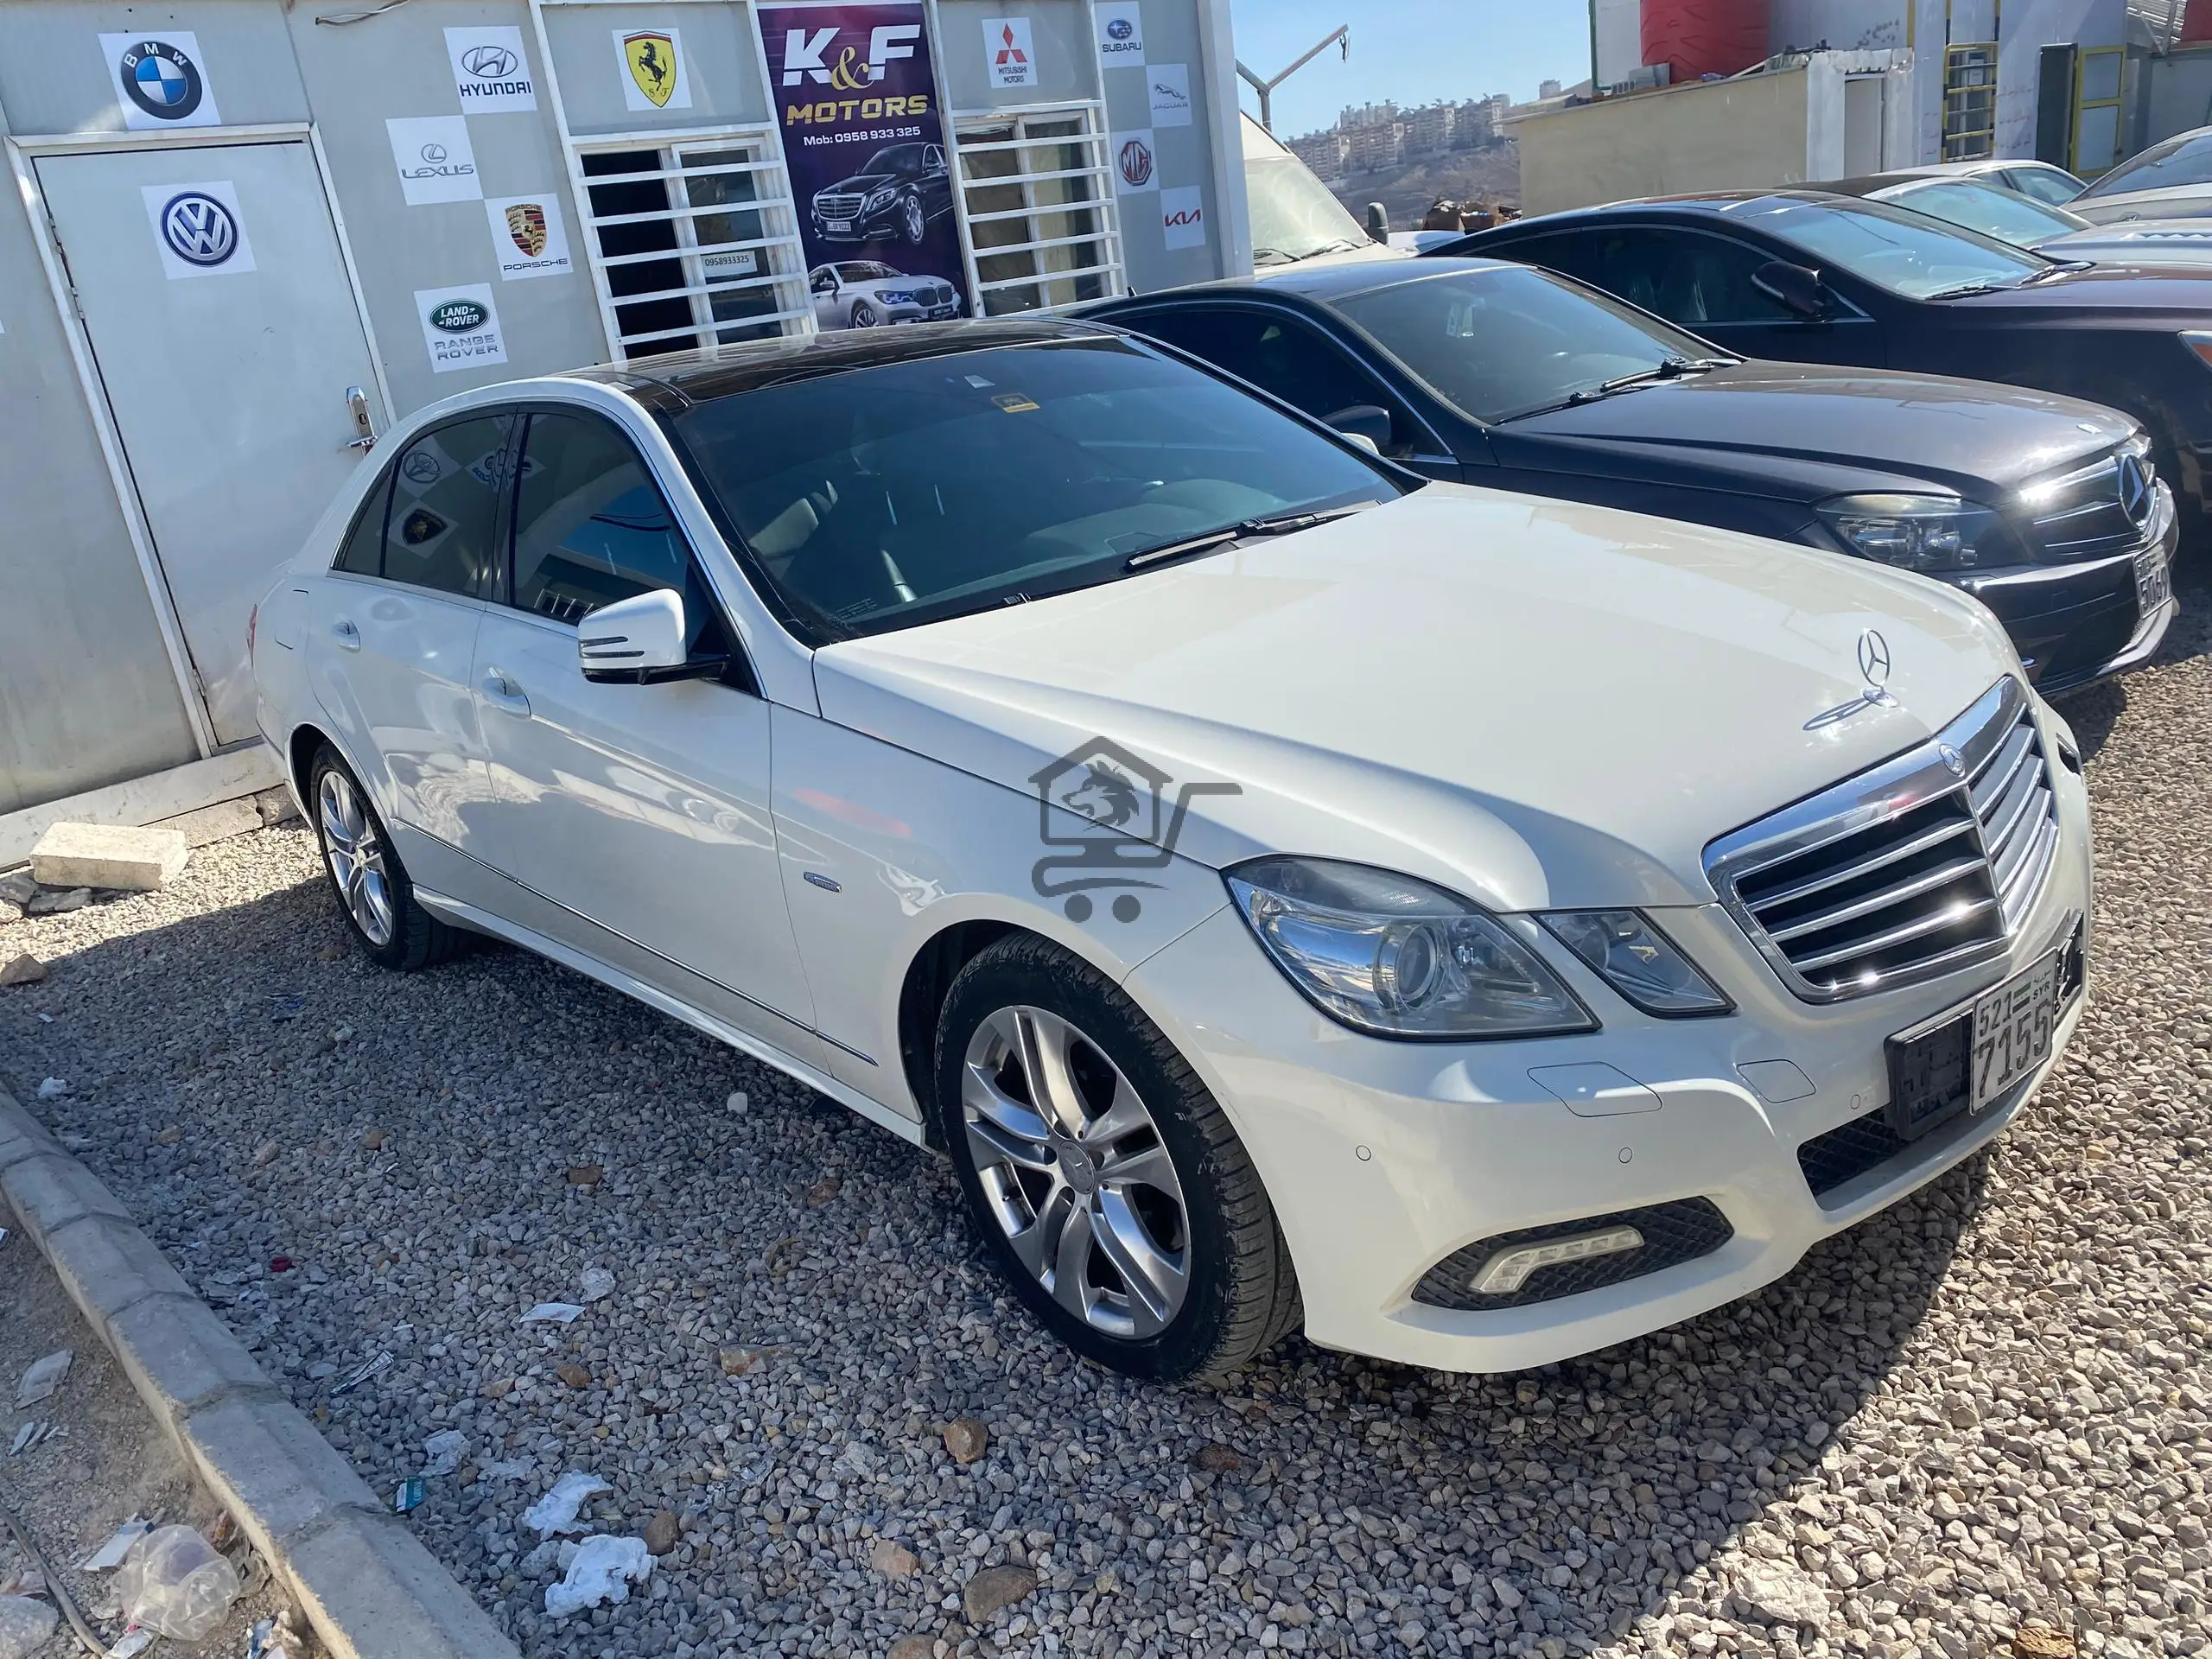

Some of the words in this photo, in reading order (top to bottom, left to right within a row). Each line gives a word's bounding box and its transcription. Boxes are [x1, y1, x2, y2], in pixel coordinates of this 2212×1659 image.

[1102, 41, 1141, 53] SUBARU
[124, 42, 188, 69] BMW
[998, 66, 1027, 75] MITSUBISHI
[1003, 75, 1025, 84] MOTORS
[459, 81, 531, 97] HYUNDAI
[786, 94, 929, 126] MOTORS
[803, 136, 834, 146] Mob:
[835, 130, 868, 143] 0958
[870, 128, 895, 140] 933
[897, 126, 921, 138] 325
[401, 164, 474, 179] LEXUS
[1164, 208, 1201, 227] KIA
[503, 257, 569, 271] PORSCHE
[704, 255, 750, 267] 0958933325
[434, 334, 496, 350] RANGE
[437, 345, 499, 360] ROVER
[2033, 981, 2050, 1001] SYR
[1980, 990, 2012, 1037] 521
[1978, 998, 2051, 1098] 7155
